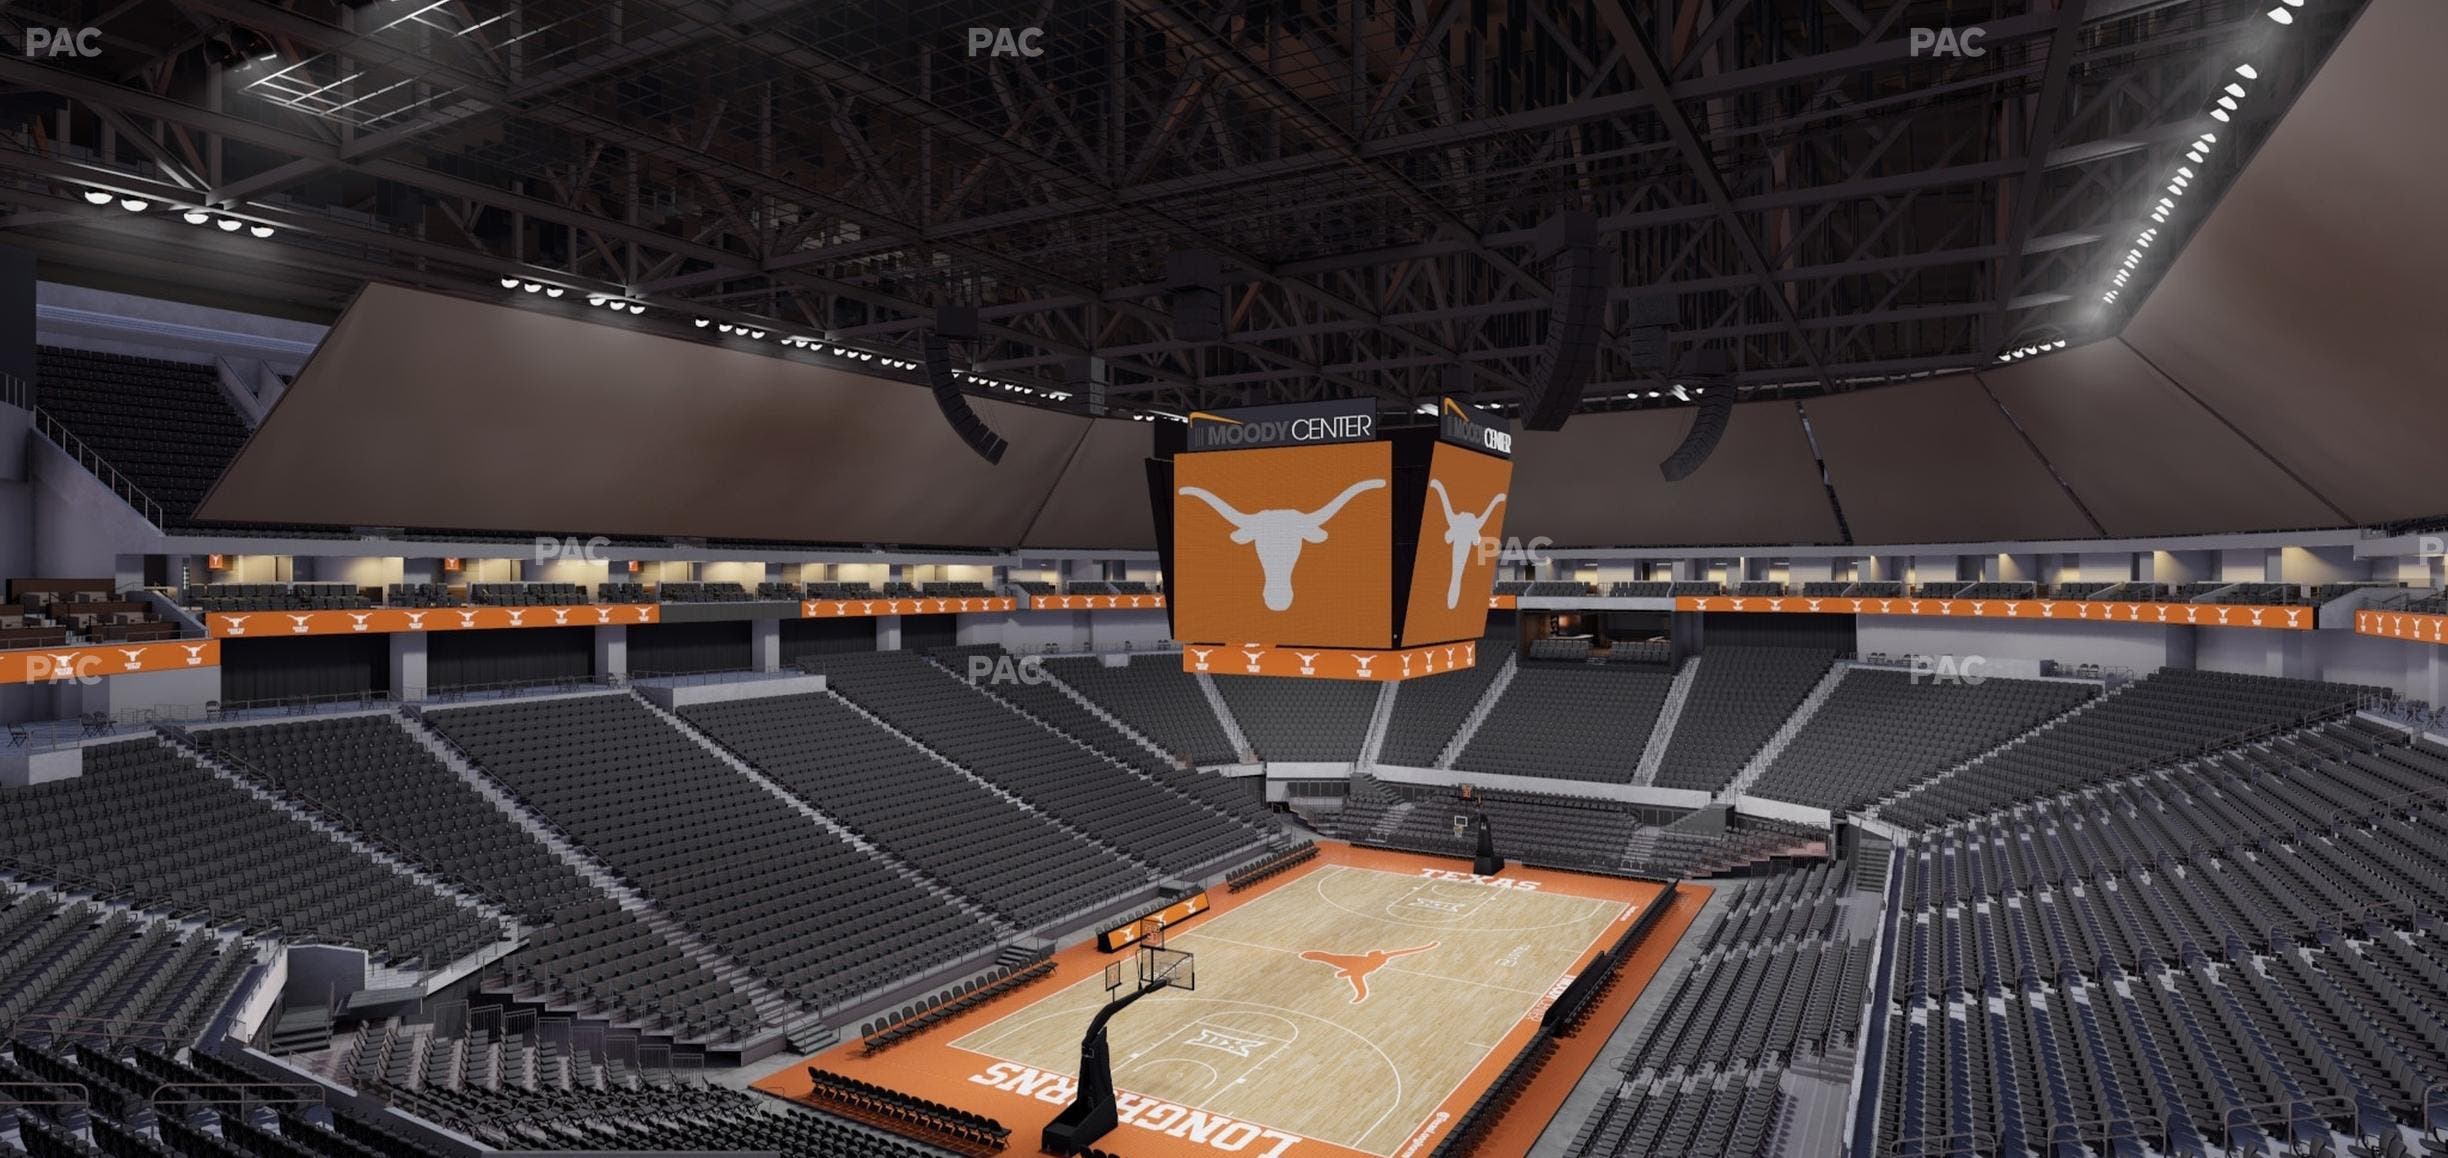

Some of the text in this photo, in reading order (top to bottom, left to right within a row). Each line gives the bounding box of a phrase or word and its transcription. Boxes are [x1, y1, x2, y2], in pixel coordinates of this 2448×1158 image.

[1207, 415, 1372, 446] MOODY CENTER
[1484, 427, 1512, 453] CENTER
[1420, 867, 1542, 891] TEXAS
[967, 1051, 1303, 1158] LONGHRNS
